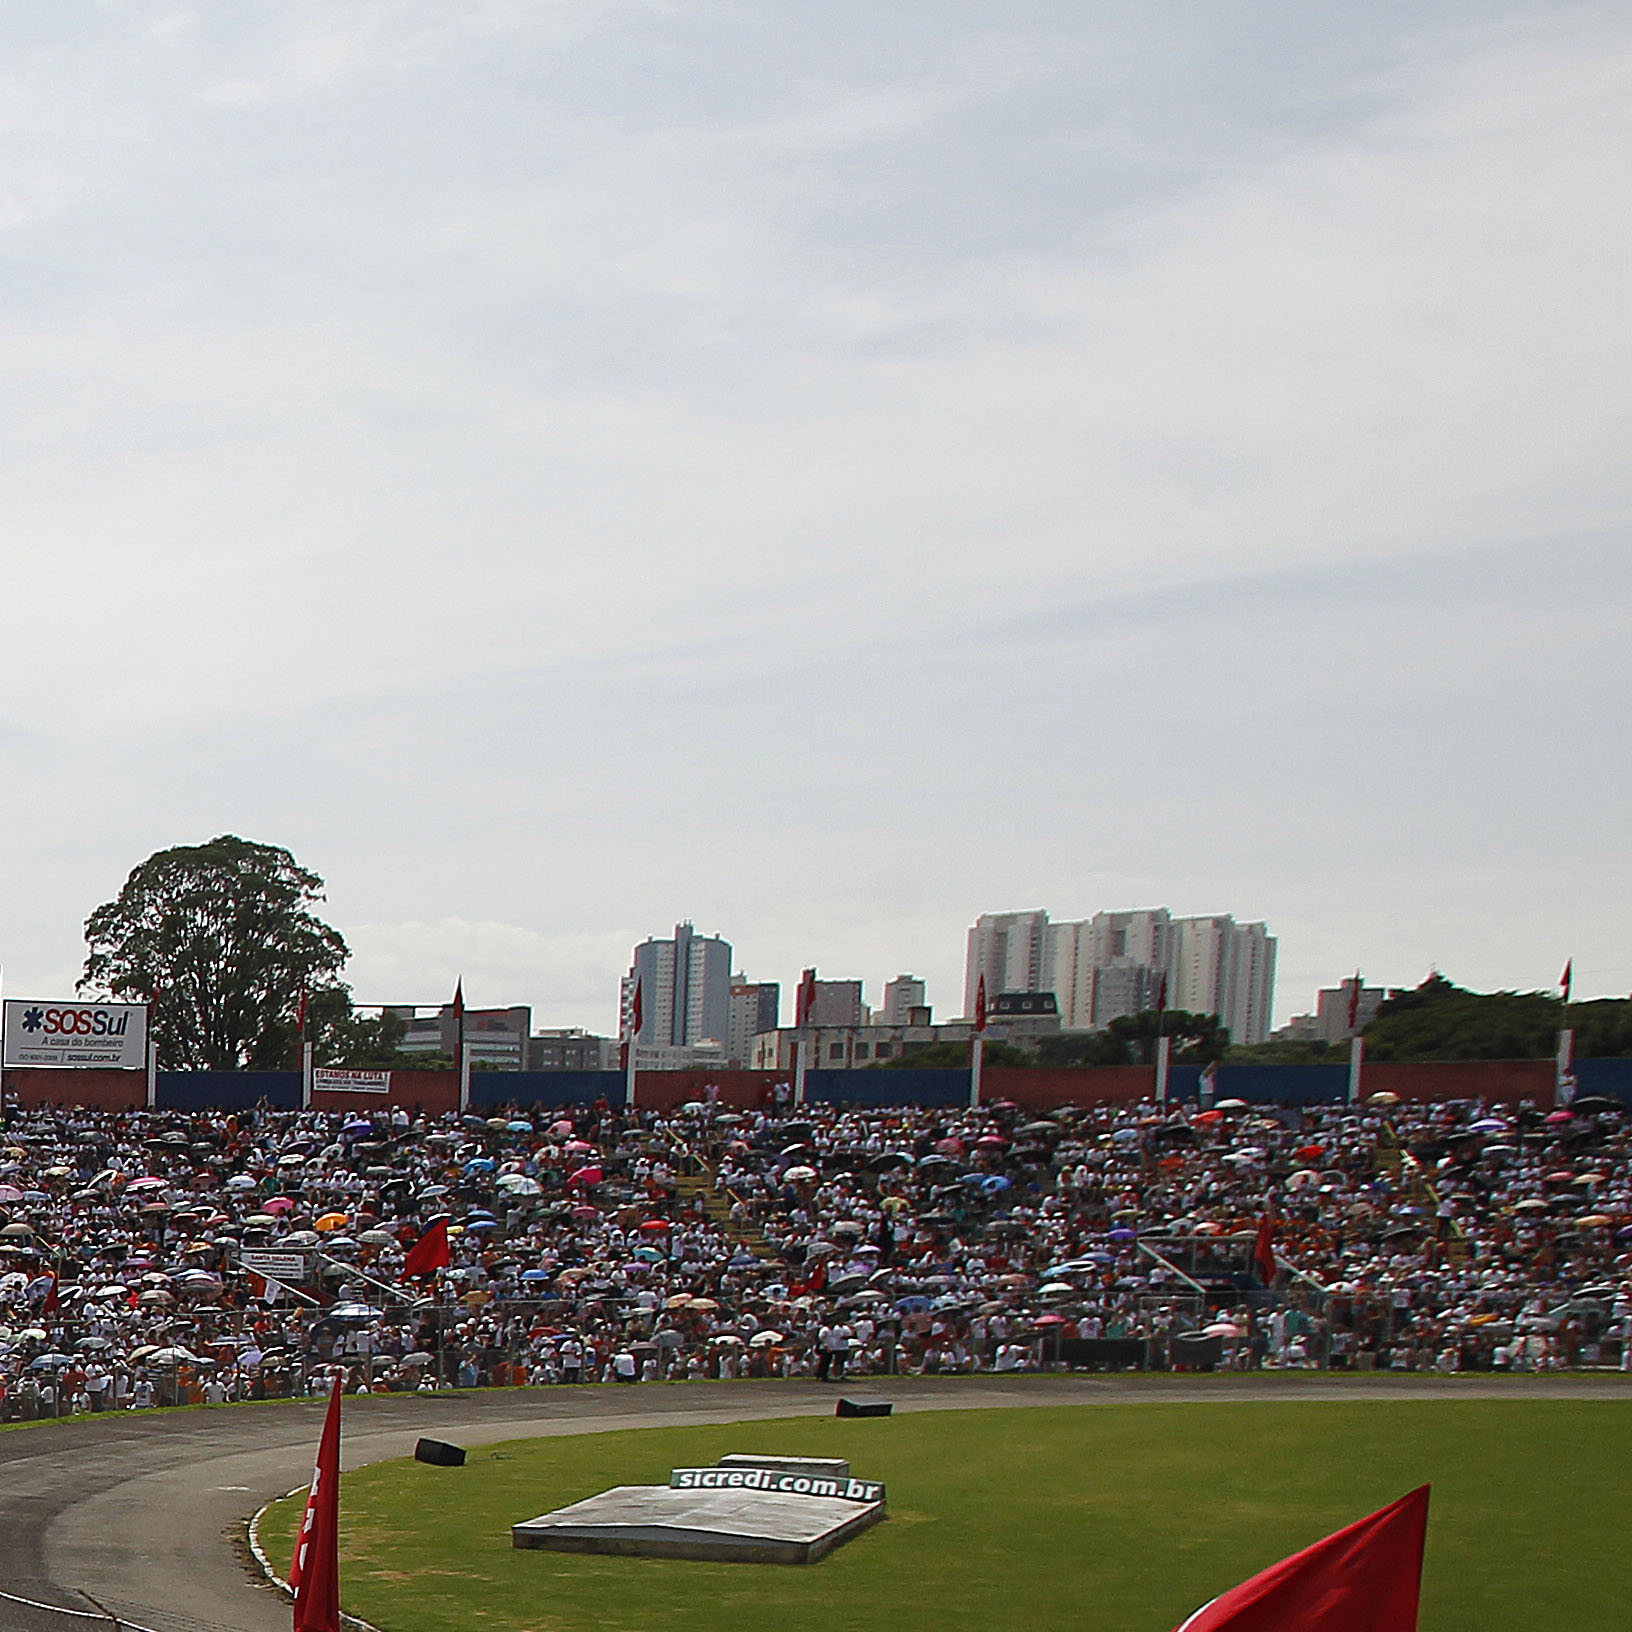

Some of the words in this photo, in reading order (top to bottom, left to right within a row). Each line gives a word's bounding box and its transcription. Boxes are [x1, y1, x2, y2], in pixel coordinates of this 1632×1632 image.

[43, 1009, 129, 1035] SOSSul
[71, 1037, 82, 1046] do
[679, 1469, 879, 1500] sicredi.com.br
